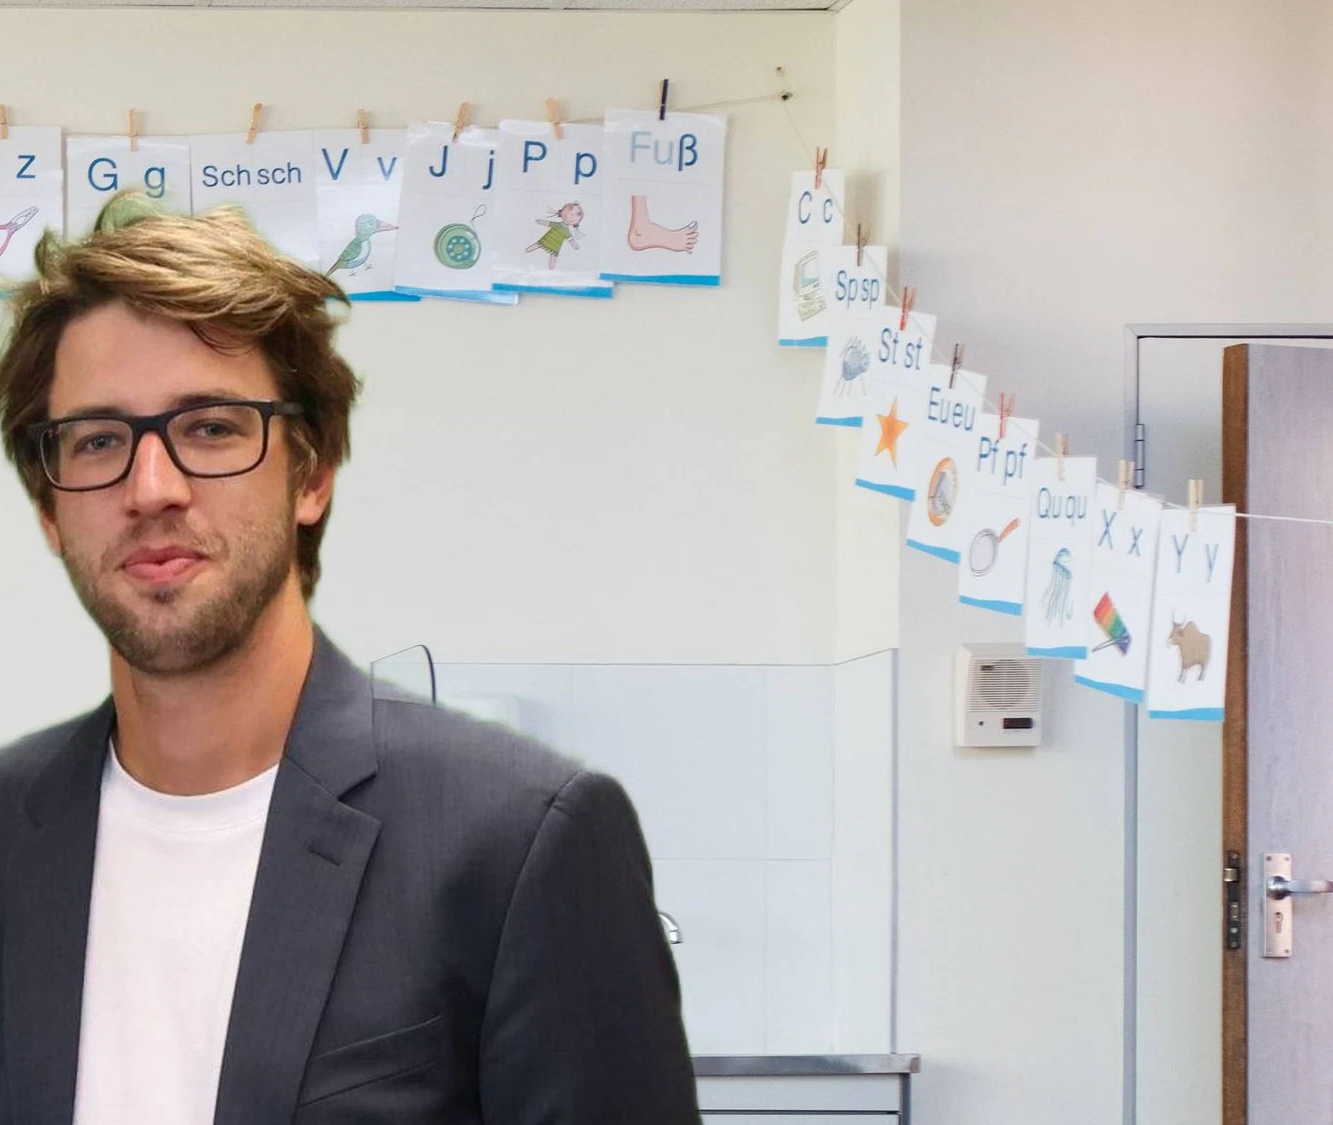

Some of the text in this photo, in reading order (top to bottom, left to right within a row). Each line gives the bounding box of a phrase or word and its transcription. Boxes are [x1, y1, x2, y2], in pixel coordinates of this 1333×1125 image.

[17, 155, 35, 178] z
[322, 148, 397, 180] V v
[429, 145, 494, 190] J j
[523, 141, 597, 185] P p
[630, 131, 699, 171] Fuß
[87, 157, 165, 198] G g
[799, 191, 833, 224] C c
[1097, 508, 1143, 557] X x
[1171, 533, 1219, 583] Y y
